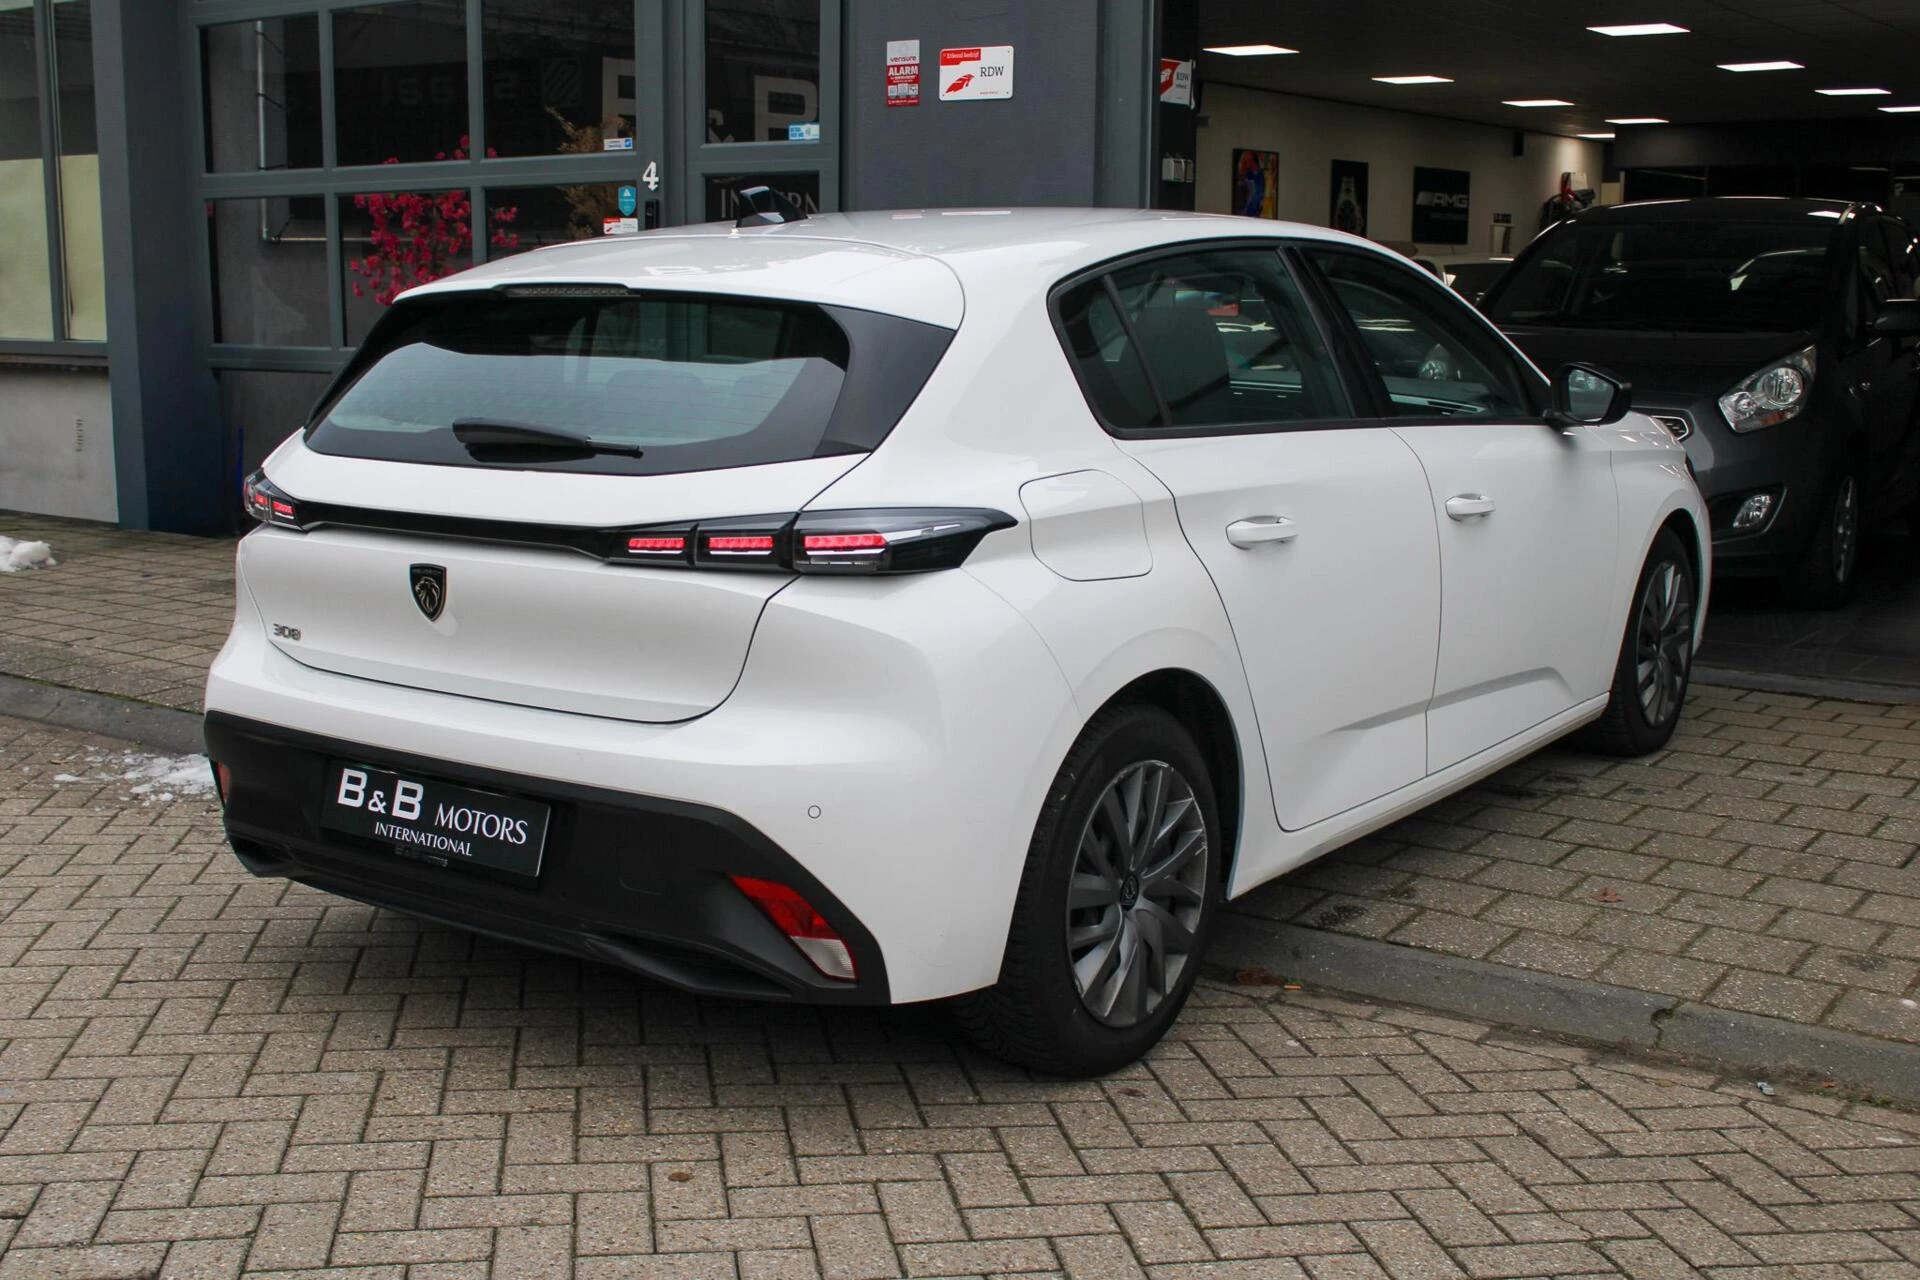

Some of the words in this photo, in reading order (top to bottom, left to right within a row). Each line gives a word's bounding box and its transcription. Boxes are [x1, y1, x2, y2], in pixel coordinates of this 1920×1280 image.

[889, 66, 919, 76] ALARM
[980, 66, 1004, 77] RDW
[642, 161, 660, 191] 4
[1432, 192, 1469, 209] AMG
[273, 623, 301, 641] 308
[434, 802, 528, 845] MOTORS
[374, 821, 473, 857] INTERNATIONAL
